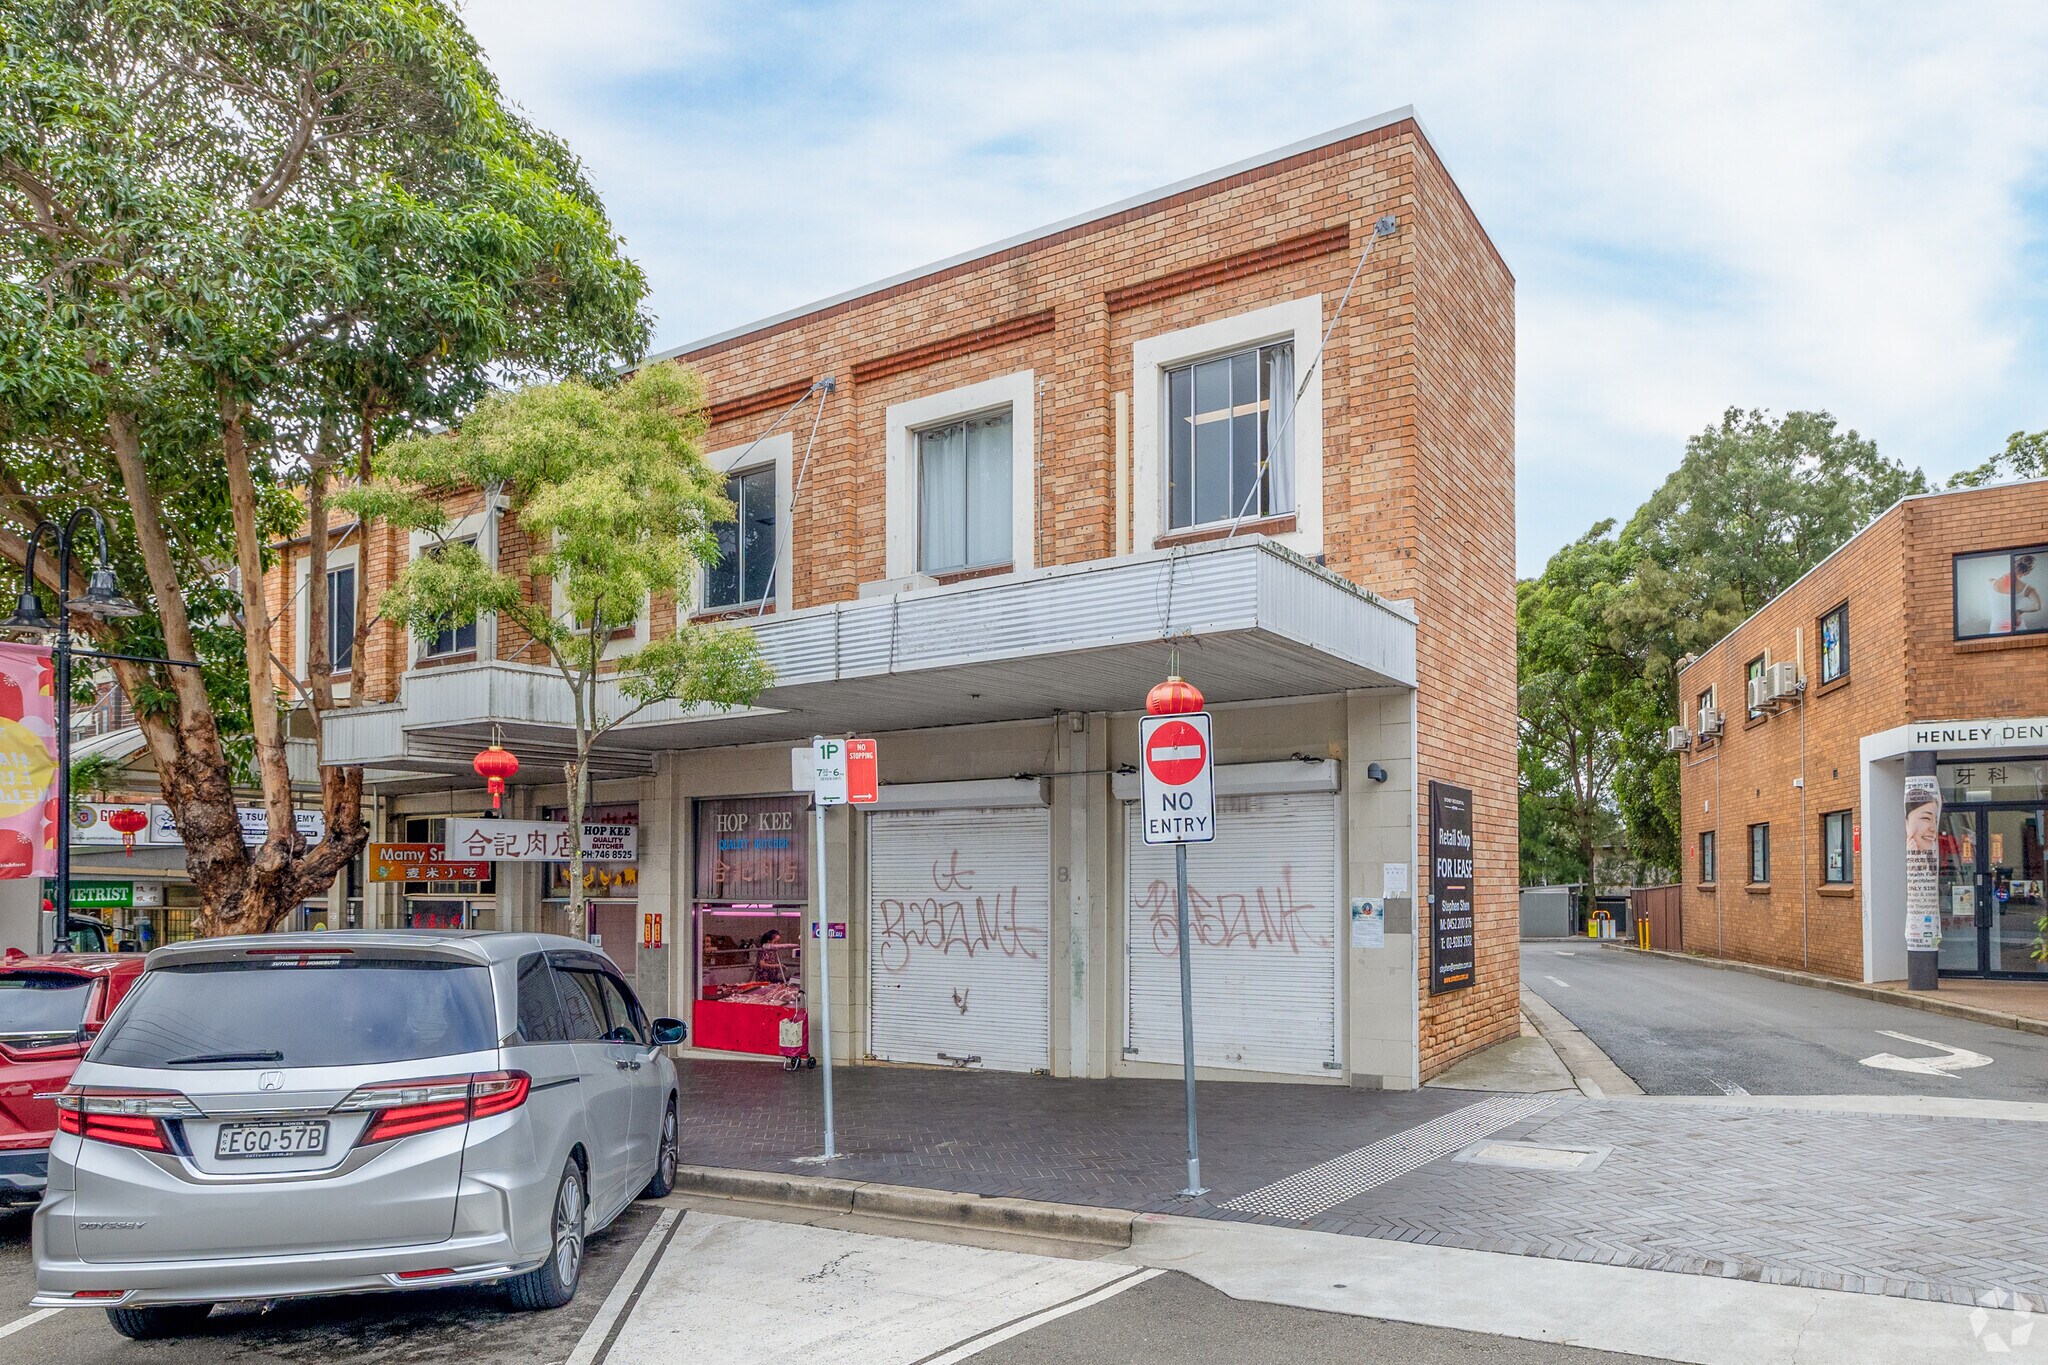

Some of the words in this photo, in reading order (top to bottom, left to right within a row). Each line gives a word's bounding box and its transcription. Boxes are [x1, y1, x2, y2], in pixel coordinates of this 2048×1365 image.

[1917, 728, 1992, 743] HENLEY
[2003, 725, 2048, 739] DEN
[821, 744, 838, 759] 1P
[1956, 766, 2008, 784] 牙科
[1162, 792, 1193, 811] NO
[716, 813, 748, 832] HOP
[758, 812, 792, 831] KEE
[1150, 816, 1207, 834] ENTRY
[584, 826, 606, 836] HOP
[610, 826, 631, 836] KEE
[1439, 828, 1456, 846] Retail
[1457, 829, 1470, 851] Shop
[462, 829, 571, 857] 合記肉店
[718, 838, 749, 851] QUALITY
[753, 838, 788, 849] BUTCHER
[380, 847, 425, 863] Mamy
[581, 850, 610, 859] PH:746
[612, 850, 632, 859] 8525
[1057, 866, 1069, 883] 8
[1437, 858, 1453, 878] FOR
[1453, 858, 1472, 878] LEASE
[1441, 900, 1459, 914] Stephen
[1460, 900, 1470, 911] Shen
[79, 1221, 147, 1230] ODYSSEY
